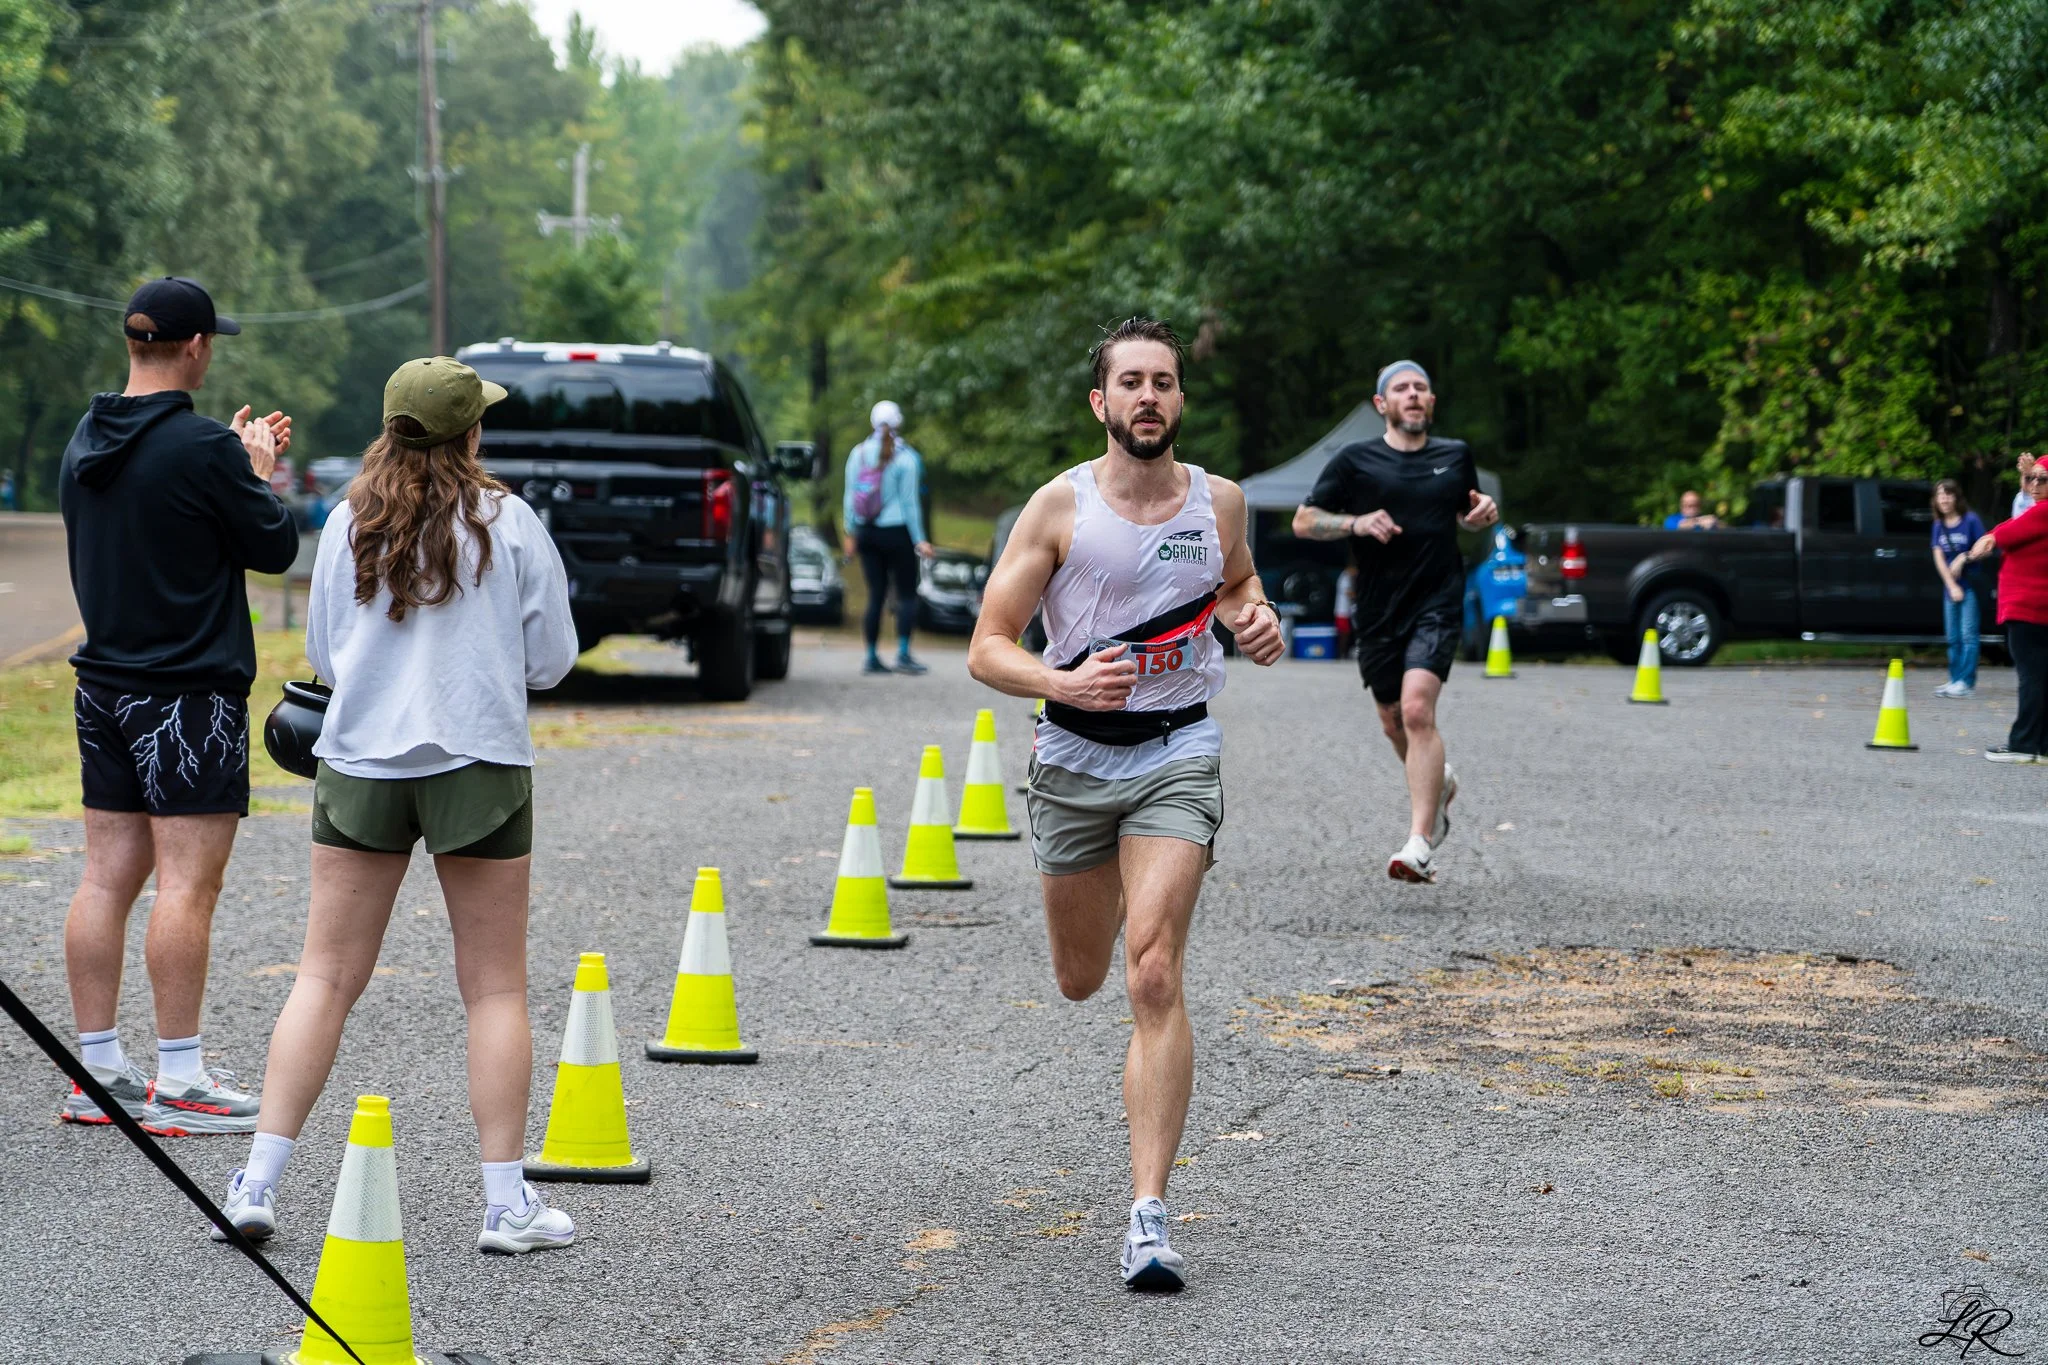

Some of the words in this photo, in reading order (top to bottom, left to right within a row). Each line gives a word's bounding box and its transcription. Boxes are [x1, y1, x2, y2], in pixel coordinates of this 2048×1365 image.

[1172, 544, 1208, 562] GRIVET
[1172, 558, 1208, 566] OUTDOORS
[1135, 649, 1184, 675] 150
[163, 1100, 232, 1116] ALTRA
